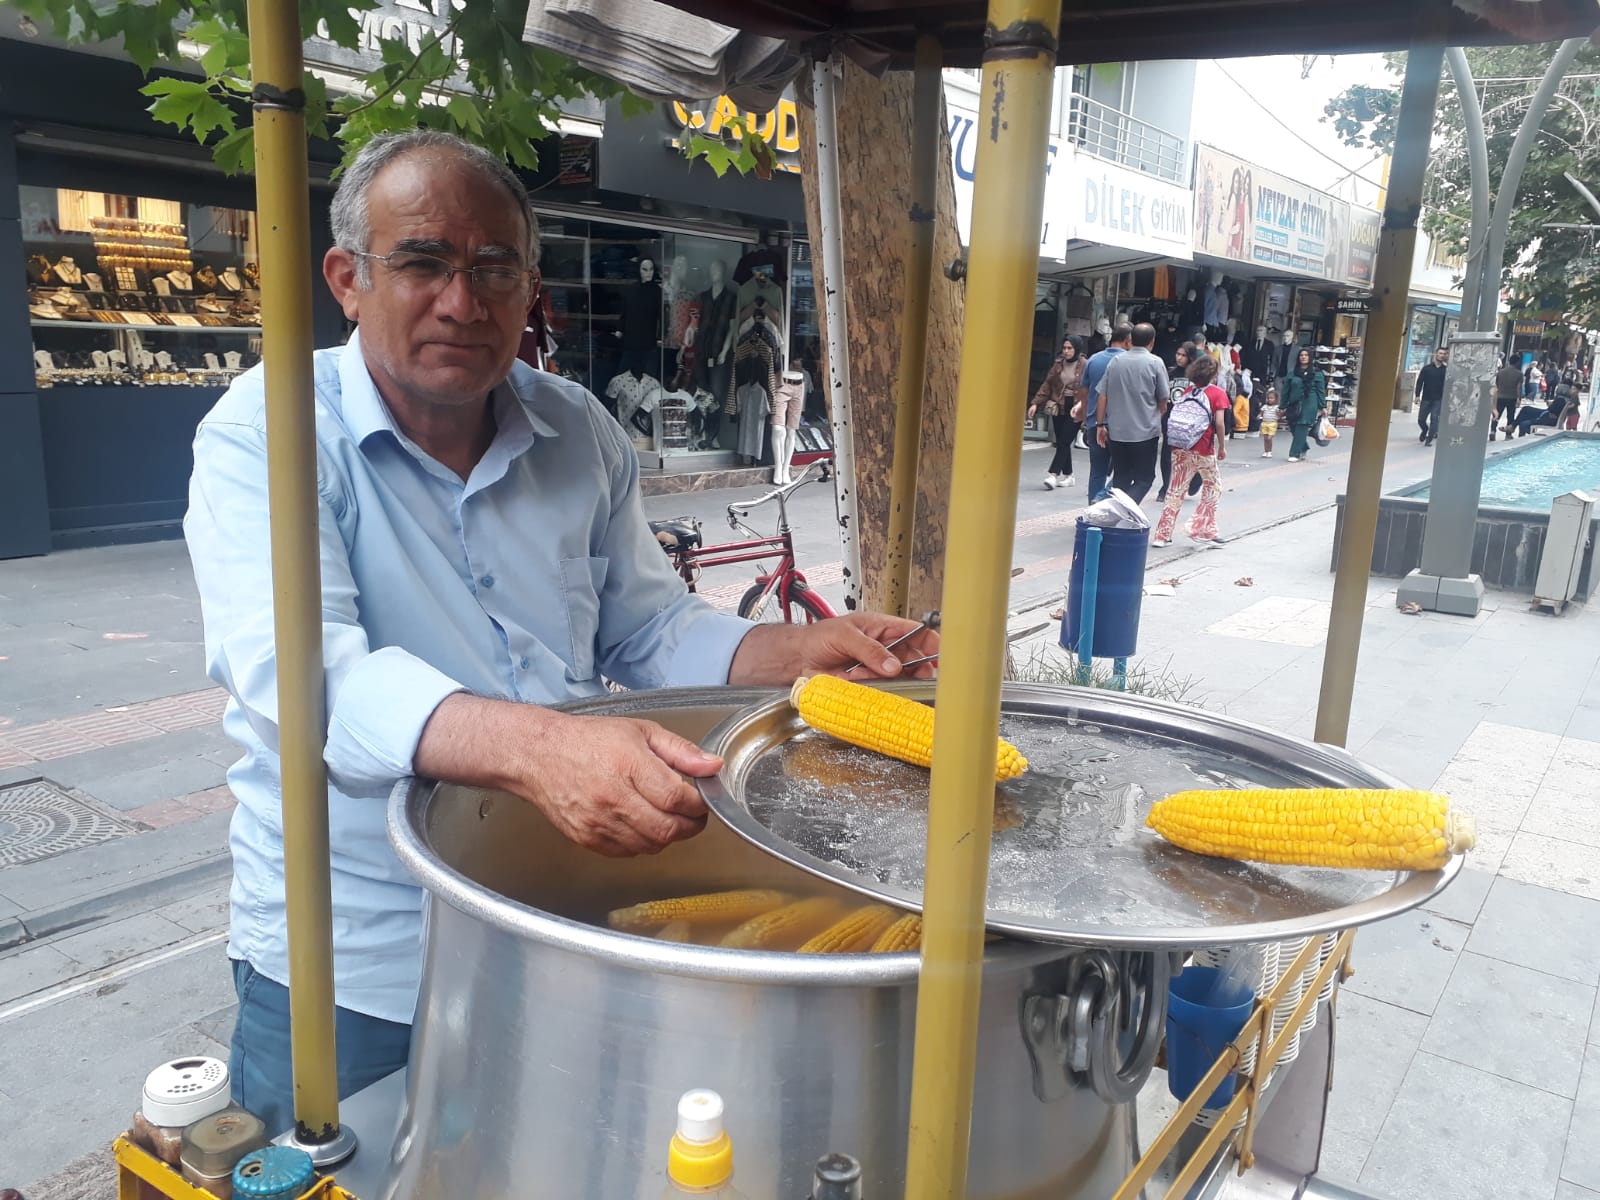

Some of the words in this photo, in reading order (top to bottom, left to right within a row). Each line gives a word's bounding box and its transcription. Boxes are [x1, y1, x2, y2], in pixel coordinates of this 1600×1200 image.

[1085, 173, 1146, 236] DİLEK
[1150, 193, 1187, 236] GİYİM
[1257, 186, 1299, 230] NEVZAT
